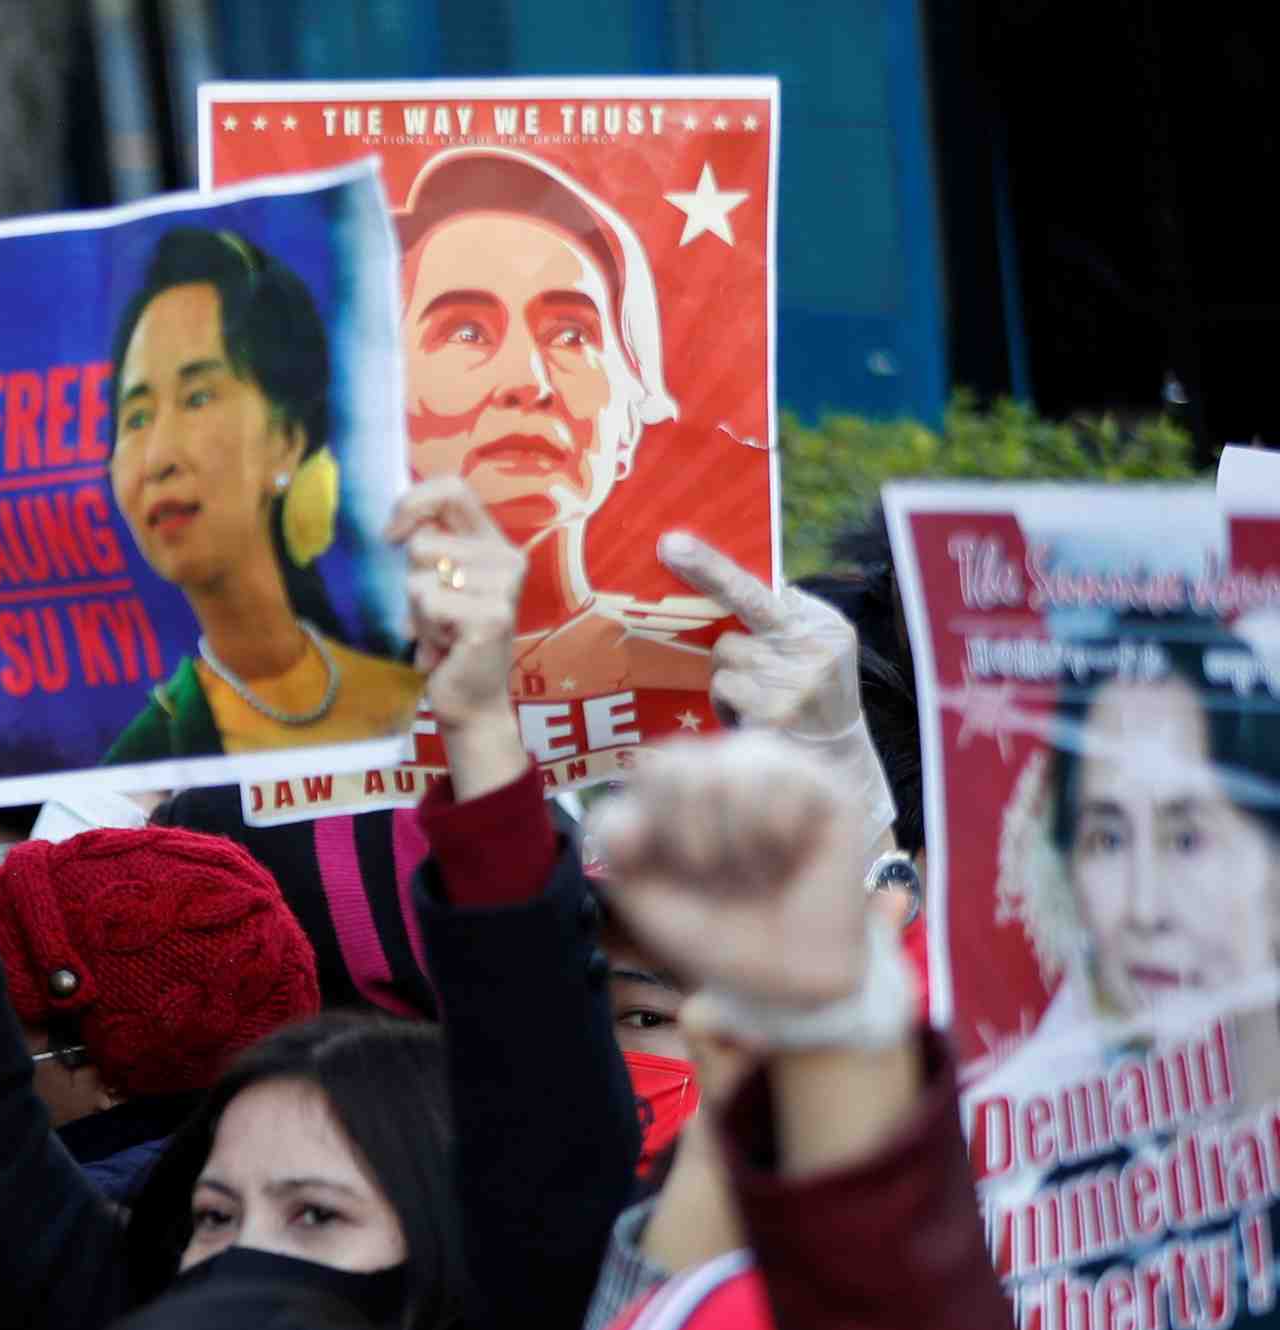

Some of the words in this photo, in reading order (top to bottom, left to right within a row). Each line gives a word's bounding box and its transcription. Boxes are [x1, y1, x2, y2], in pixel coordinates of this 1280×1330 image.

[323, 108, 382, 137] THE
[403, 107, 473, 136] WAY
[493, 107, 540, 136] WE
[561, 105, 665, 135] TRUST
[69, 595, 165, 687] KYI
[965, 1012, 1240, 1181] Demand
